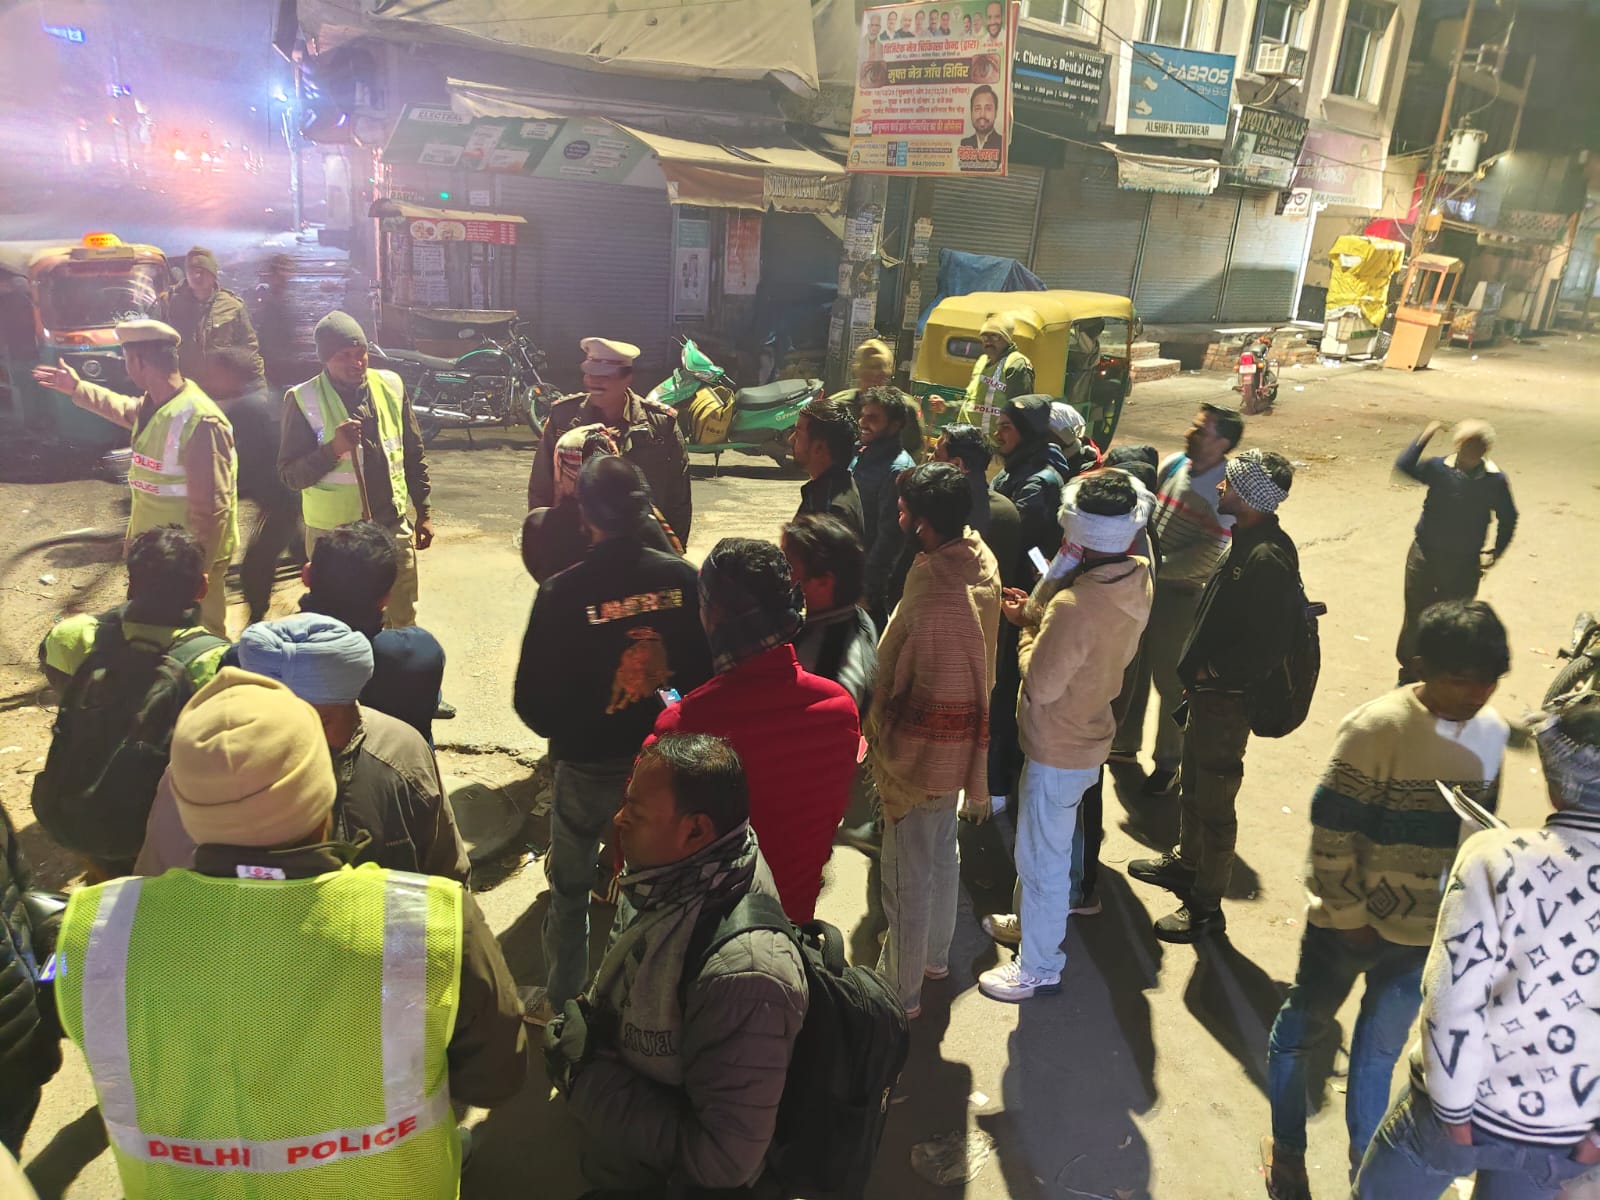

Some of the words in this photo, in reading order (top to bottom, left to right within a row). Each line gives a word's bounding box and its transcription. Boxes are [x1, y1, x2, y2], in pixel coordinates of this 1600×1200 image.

[943, 63, 970, 78] शिविर
[1023, 50, 1058, 69] Chetna's
[1059, 58, 1084, 75] Dental
[1085, 64, 1103, 79] Care
[1145, 121, 1174, 134] ALSHIFA
[1175, 123, 1209, 136] FOOTWEAR
[1240, 110, 1266, 132] JYOTI
[1266, 115, 1306, 141] OPTICALS
[148, 1140, 251, 1168] DELHI
[286, 1114, 419, 1165] POLICE
